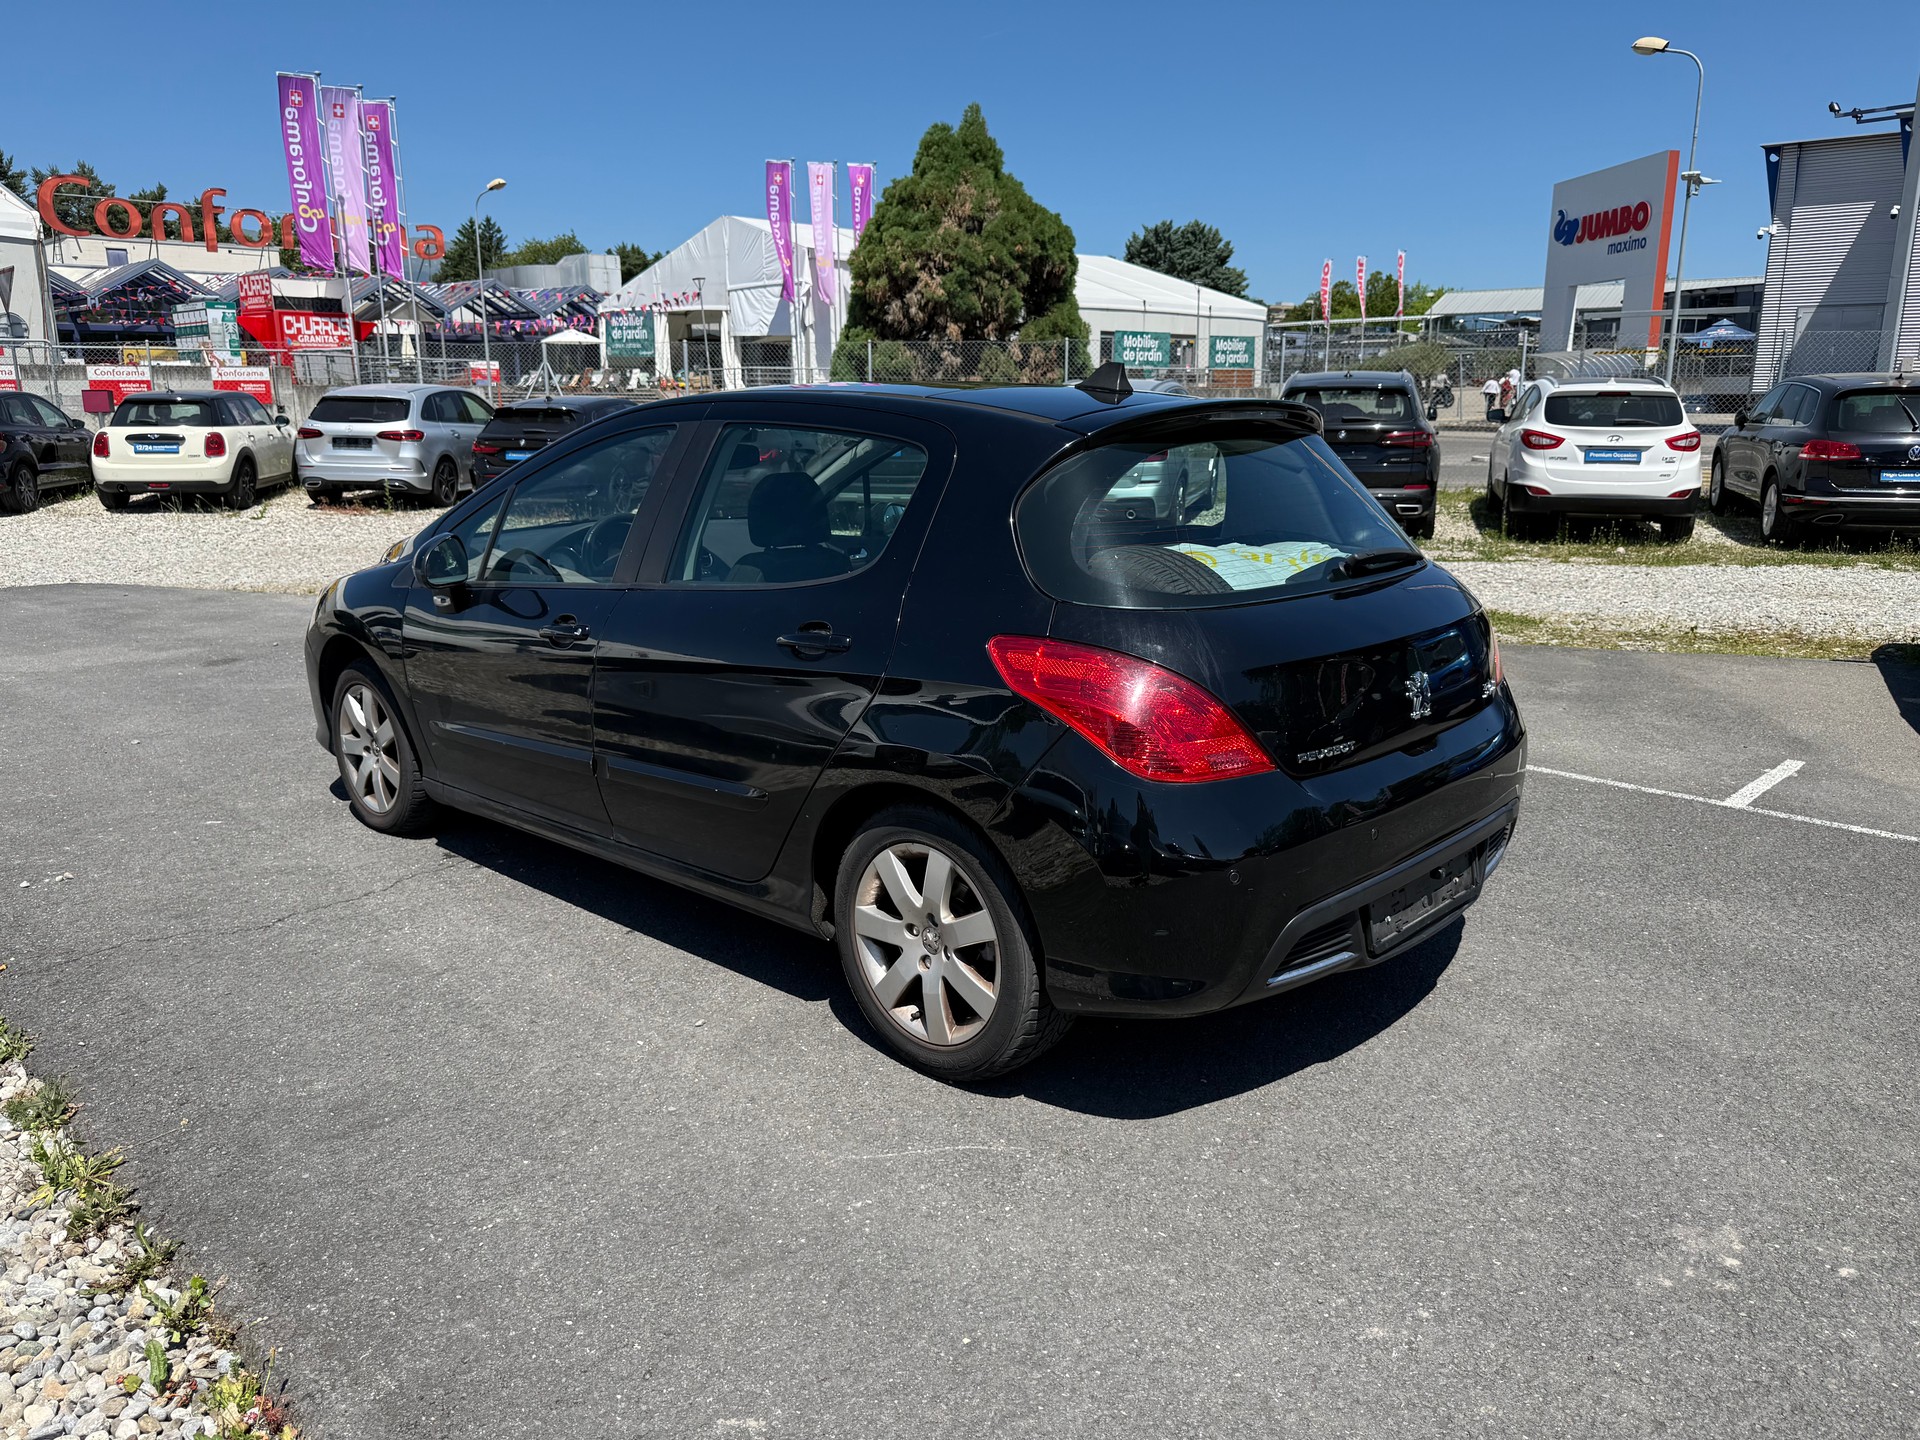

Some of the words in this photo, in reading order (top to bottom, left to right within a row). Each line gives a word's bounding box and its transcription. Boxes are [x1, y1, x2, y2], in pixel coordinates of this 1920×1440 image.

[36, 174, 446, 260] Confora
[1575, 200, 1651, 244] JUMBO
[1606, 235, 1647, 255] maximo
[283, 315, 350, 336] CHURROS
[297, 334, 340, 344] GRANITAS
[612, 328, 622, 340] de
[623, 327, 648, 343] jardin
[1123, 334, 1159, 349] Mobilier
[1215, 338, 1246, 351] Mobilier
[1123, 350, 1134, 361] de
[1135, 350, 1163, 364] jardin
[1215, 353, 1225, 363] de
[1225, 352, 1248, 367] jardin
[94, 368, 146, 377] Conforama
[1298, 741, 1356, 764] PEUGEOT
